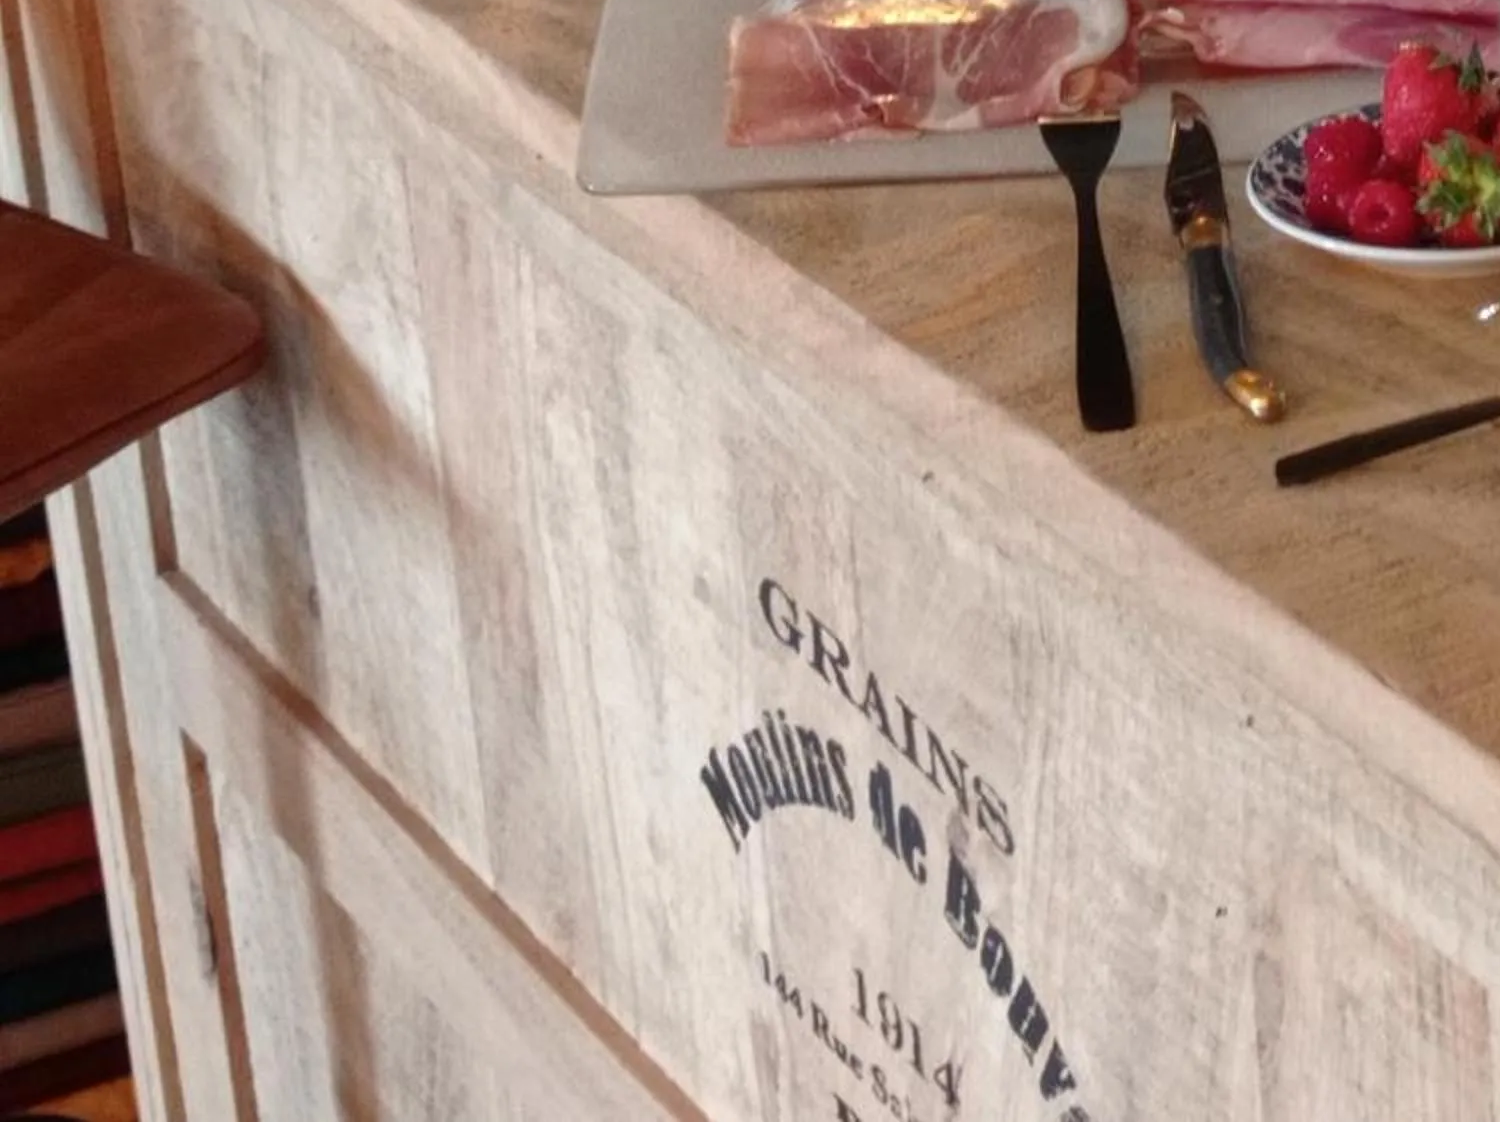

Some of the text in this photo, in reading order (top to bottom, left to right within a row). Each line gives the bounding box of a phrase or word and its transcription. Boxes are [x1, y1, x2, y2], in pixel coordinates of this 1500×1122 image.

[759, 577, 1015, 856] GRAINS
[700, 708, 856, 855] Moulins
[868, 759, 928, 885] de
[810, 998, 865, 1081] Rue
[852, 967, 963, 1108] 1914
